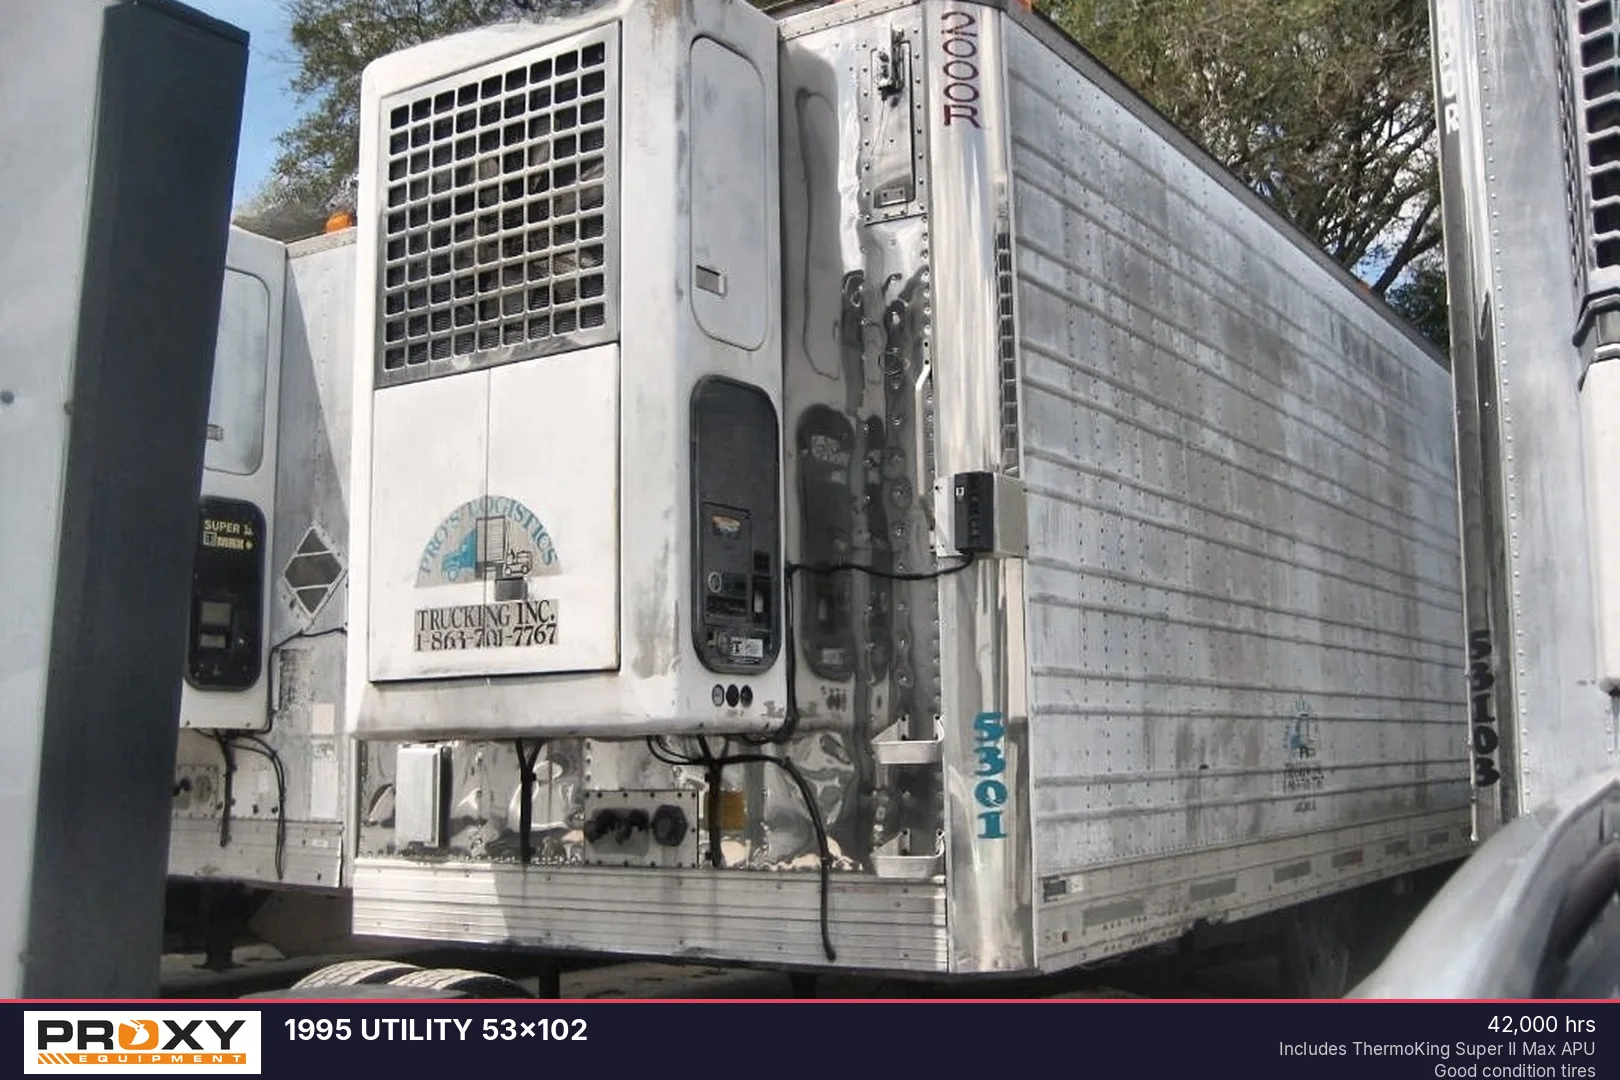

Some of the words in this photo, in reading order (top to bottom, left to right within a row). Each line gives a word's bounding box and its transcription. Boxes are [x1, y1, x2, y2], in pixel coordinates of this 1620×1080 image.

[941, 11, 981, 129] 2000R
[203, 519, 241, 534] SUPER
[416, 624, 558, 651] 1-863-701-7767
[417, 603, 511, 630] TRUCKING
[517, 600, 555, 624] INC.
[1470, 630, 1501, 787] 53103
[973, 711, 1008, 840] 5301
